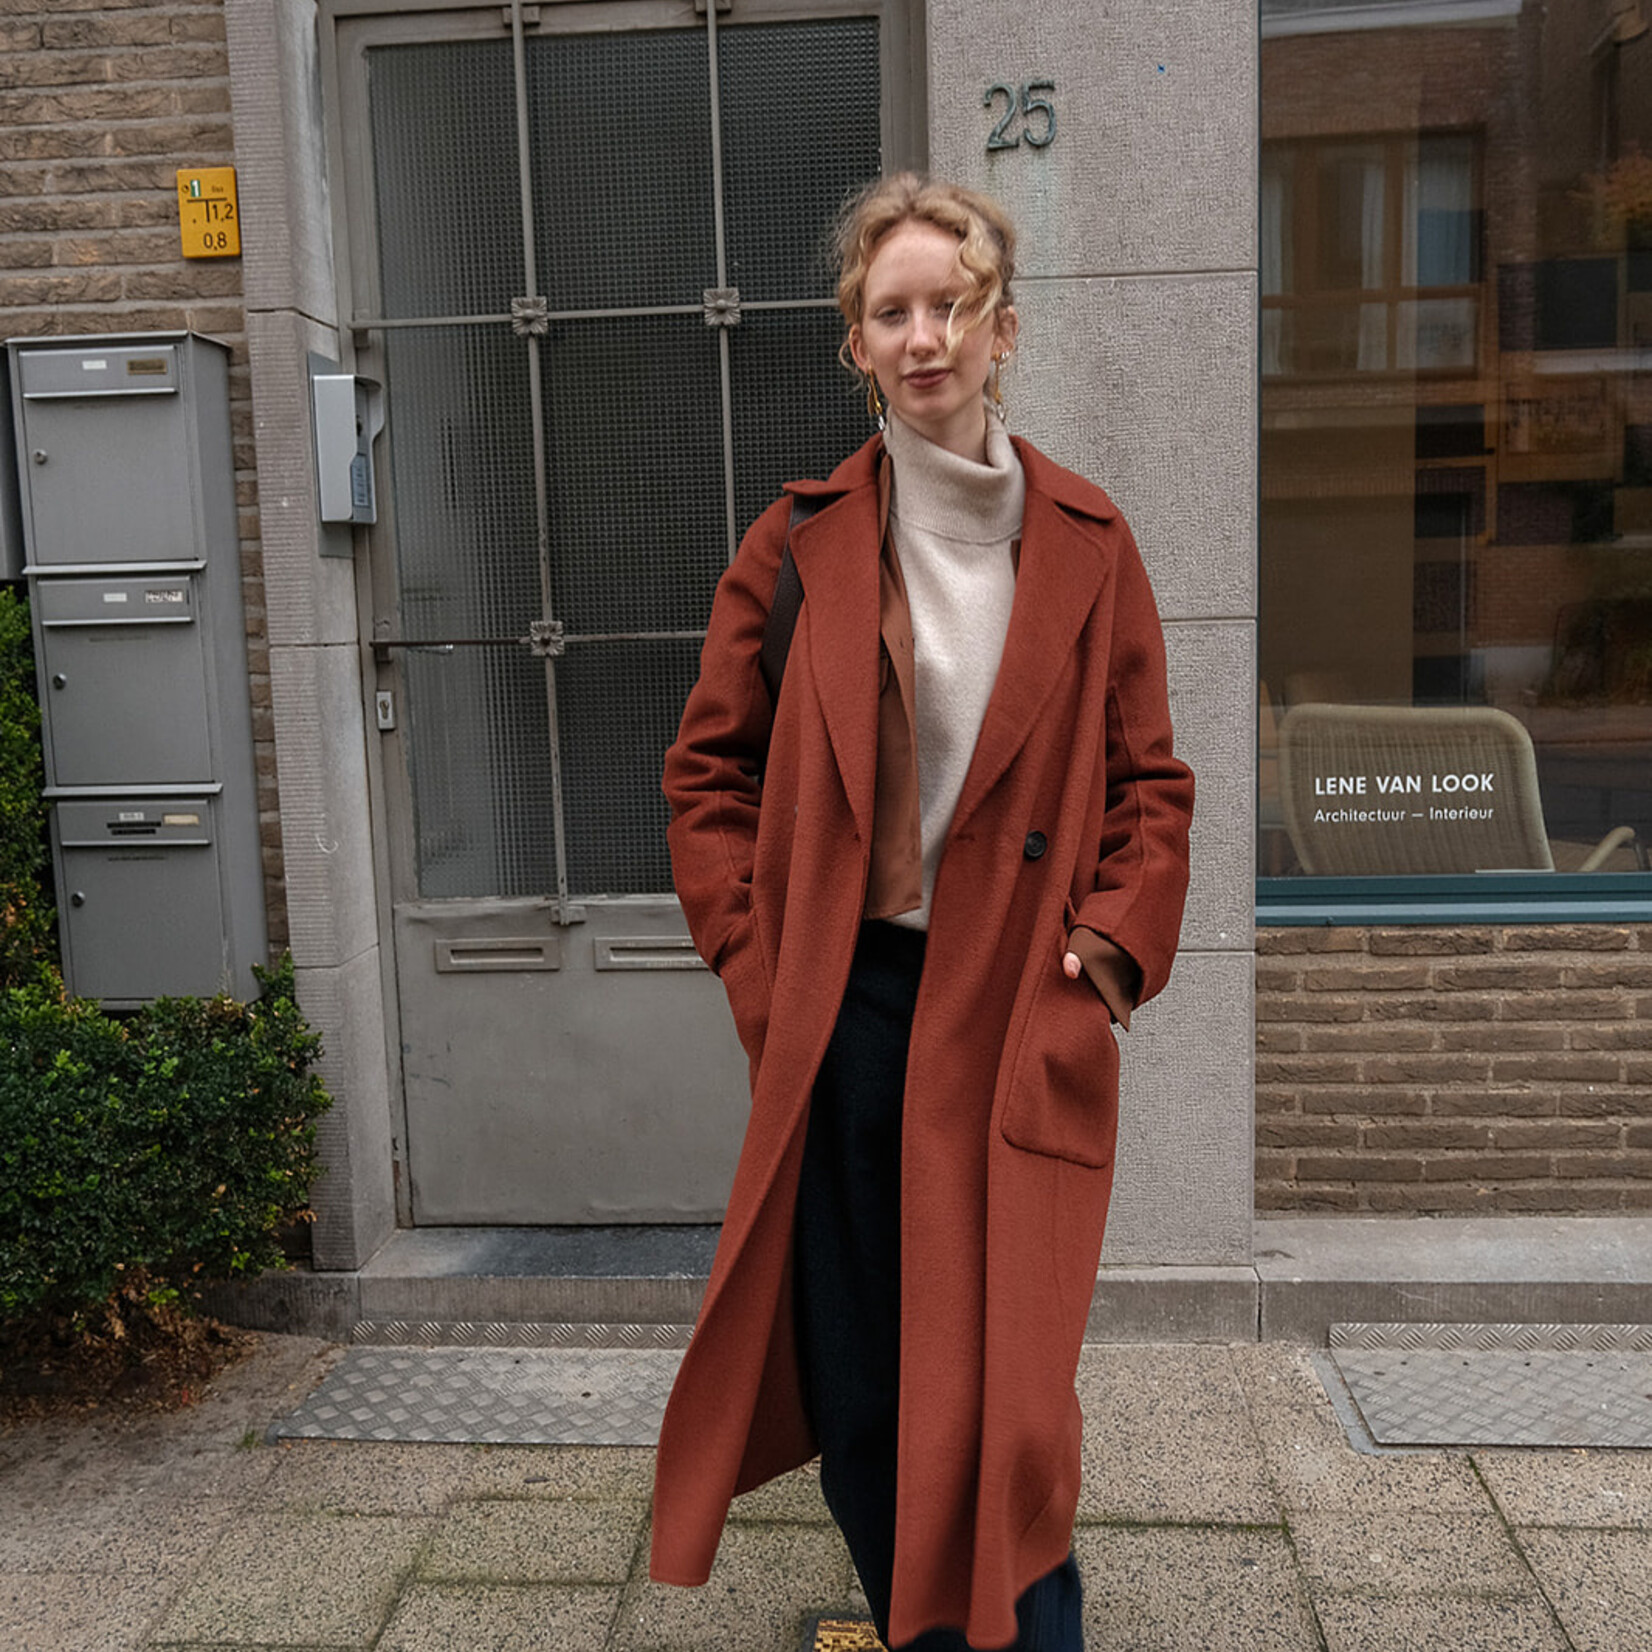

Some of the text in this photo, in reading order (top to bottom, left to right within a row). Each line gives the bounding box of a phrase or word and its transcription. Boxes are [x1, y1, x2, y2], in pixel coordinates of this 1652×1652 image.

[983, 79, 1056, 151] 25
[191, 180, 200, 197] 1
[203, 231, 227, 250] 0,8
[1314, 773, 1494, 795] LENE VAN LOOK
[1314, 807, 1406, 823] Architectuur
[1429, 806, 1494, 820] Interieur
